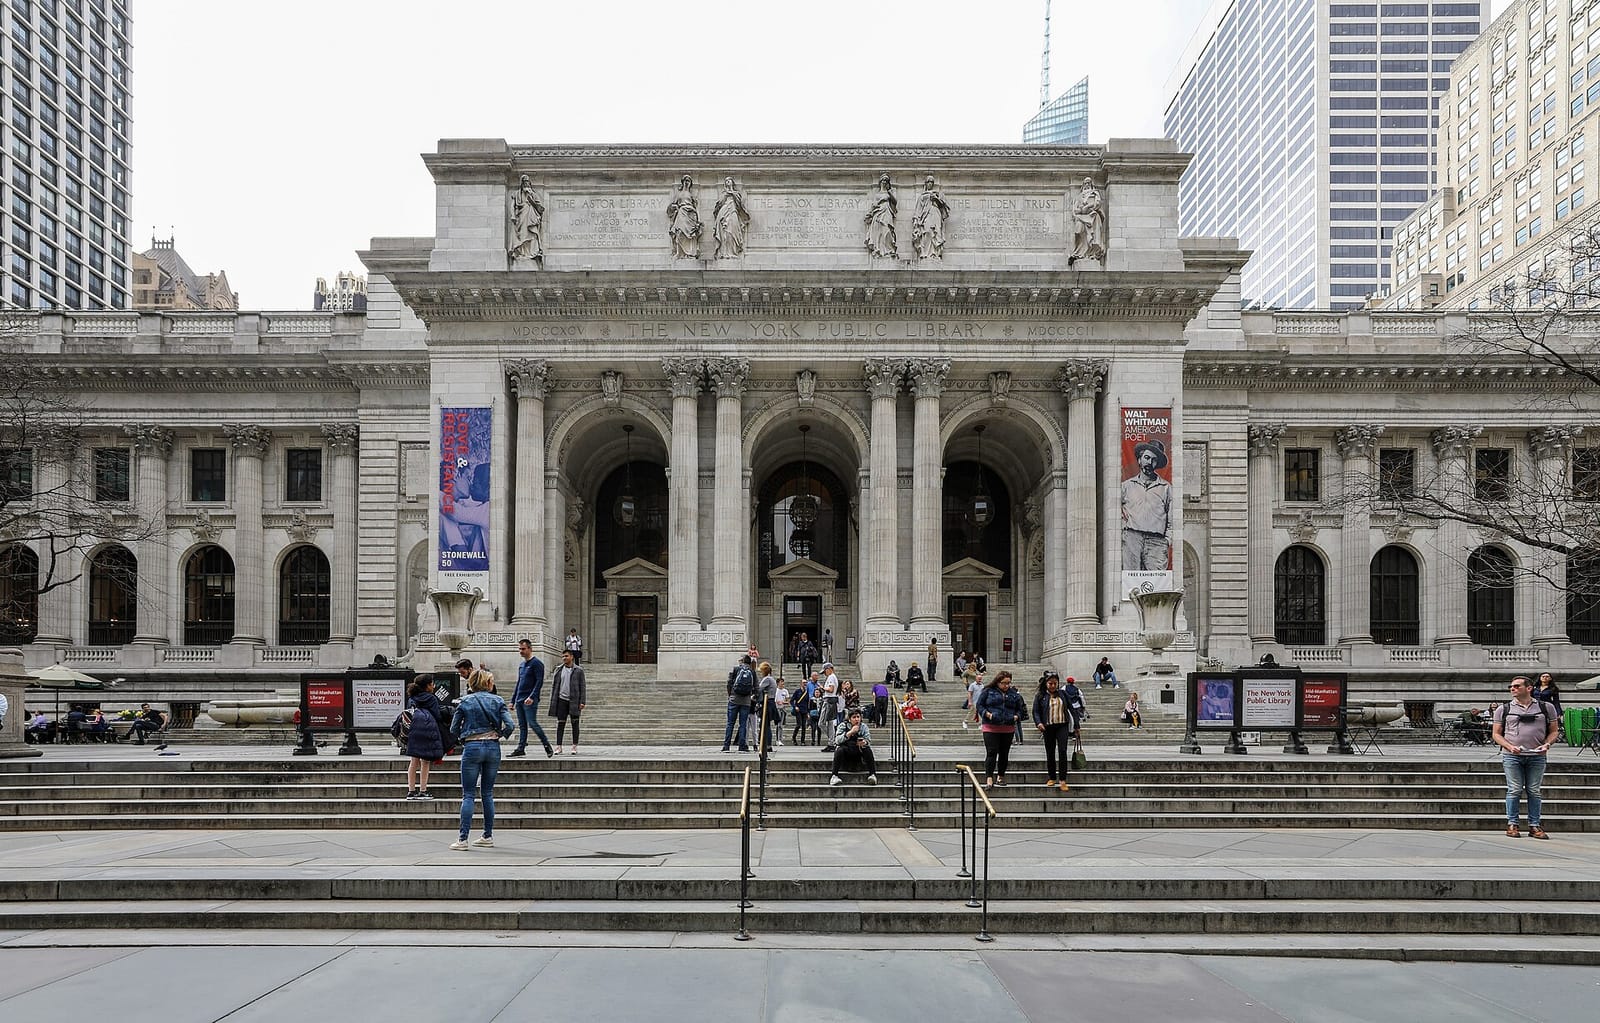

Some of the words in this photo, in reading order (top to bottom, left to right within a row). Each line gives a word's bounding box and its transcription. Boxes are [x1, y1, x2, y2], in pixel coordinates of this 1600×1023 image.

[556, 199, 576, 208] THE
[582, 199, 615, 208] ASTOR
[620, 199, 664, 208] LIBRARY
[753, 199, 773, 208] THE
[778, 199, 812, 208] LENOX
[818, 199, 861, 208] LIBRARY
[950, 199, 970, 208] THE
[980, 199, 1016, 208] TILDEN
[1024, 199, 1058, 208] TRUST
[512, 326, 584, 336] MDCCCXCV
[628, 322, 668, 338] THE
[682, 322, 732, 338] NEW
[750, 322, 801, 338] YORK
[817, 322, 888, 338] PUBLIC
[906, 322, 989, 338] LIBRARY
[1028, 326, 1094, 336] MDCCCCII
[457, 413, 468, 454] LOVE
[443, 414, 455, 514] RESISTANCE
[442, 551, 486, 559] STONEWALL
